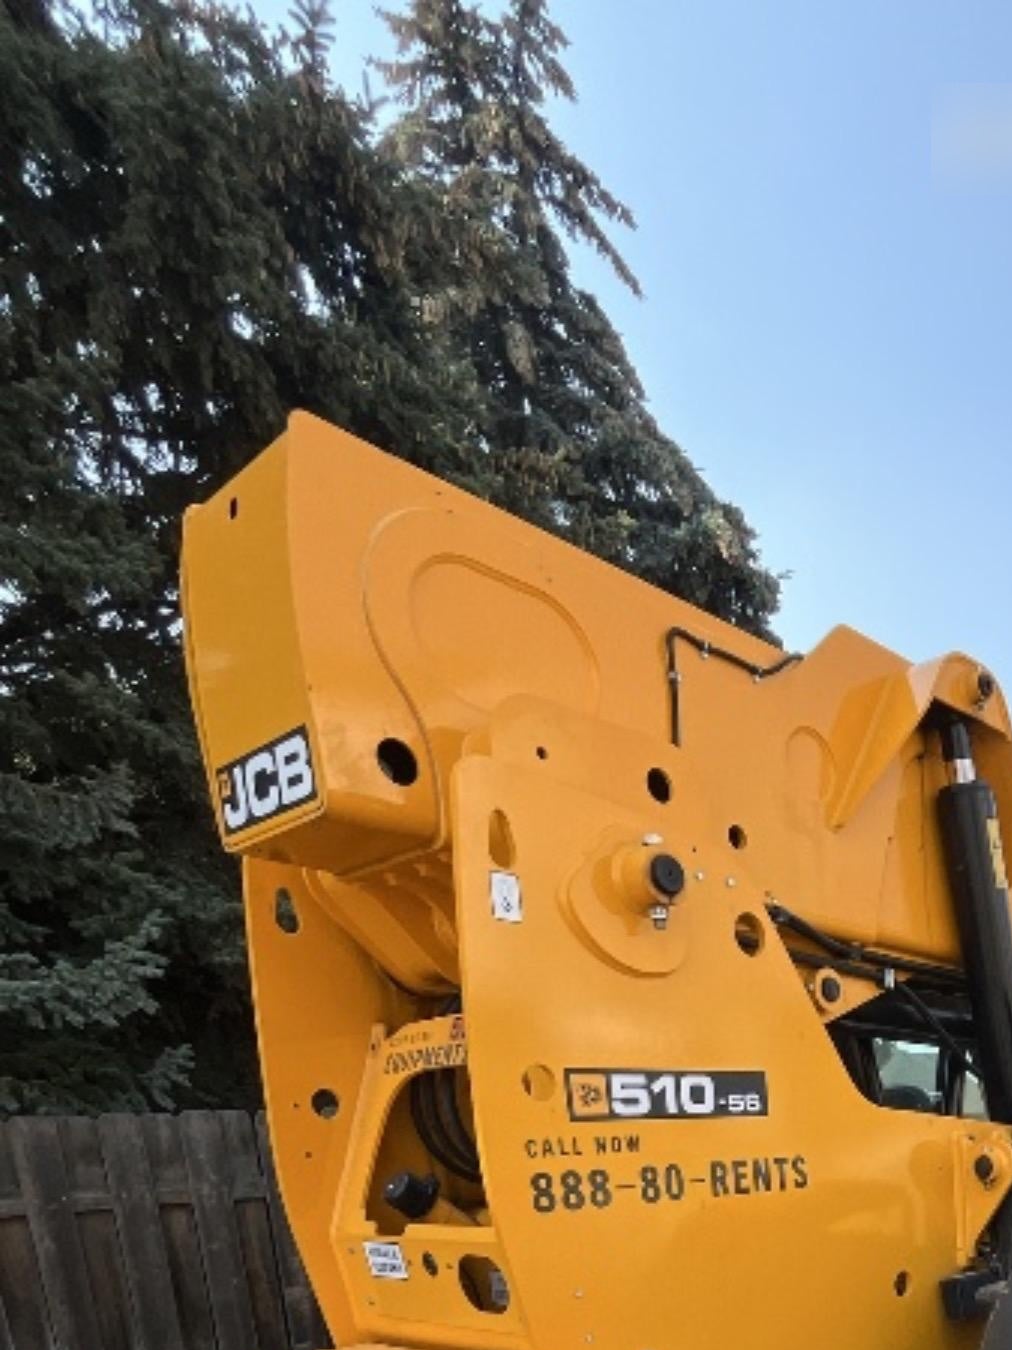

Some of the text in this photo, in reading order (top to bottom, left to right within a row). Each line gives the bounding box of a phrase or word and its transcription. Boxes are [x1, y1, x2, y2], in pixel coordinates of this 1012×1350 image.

[221, 734, 313, 828] JCB
[525, 1133, 640, 1158] CALL NOW
[530, 1155, 808, 1213] 888-80-RENTS
